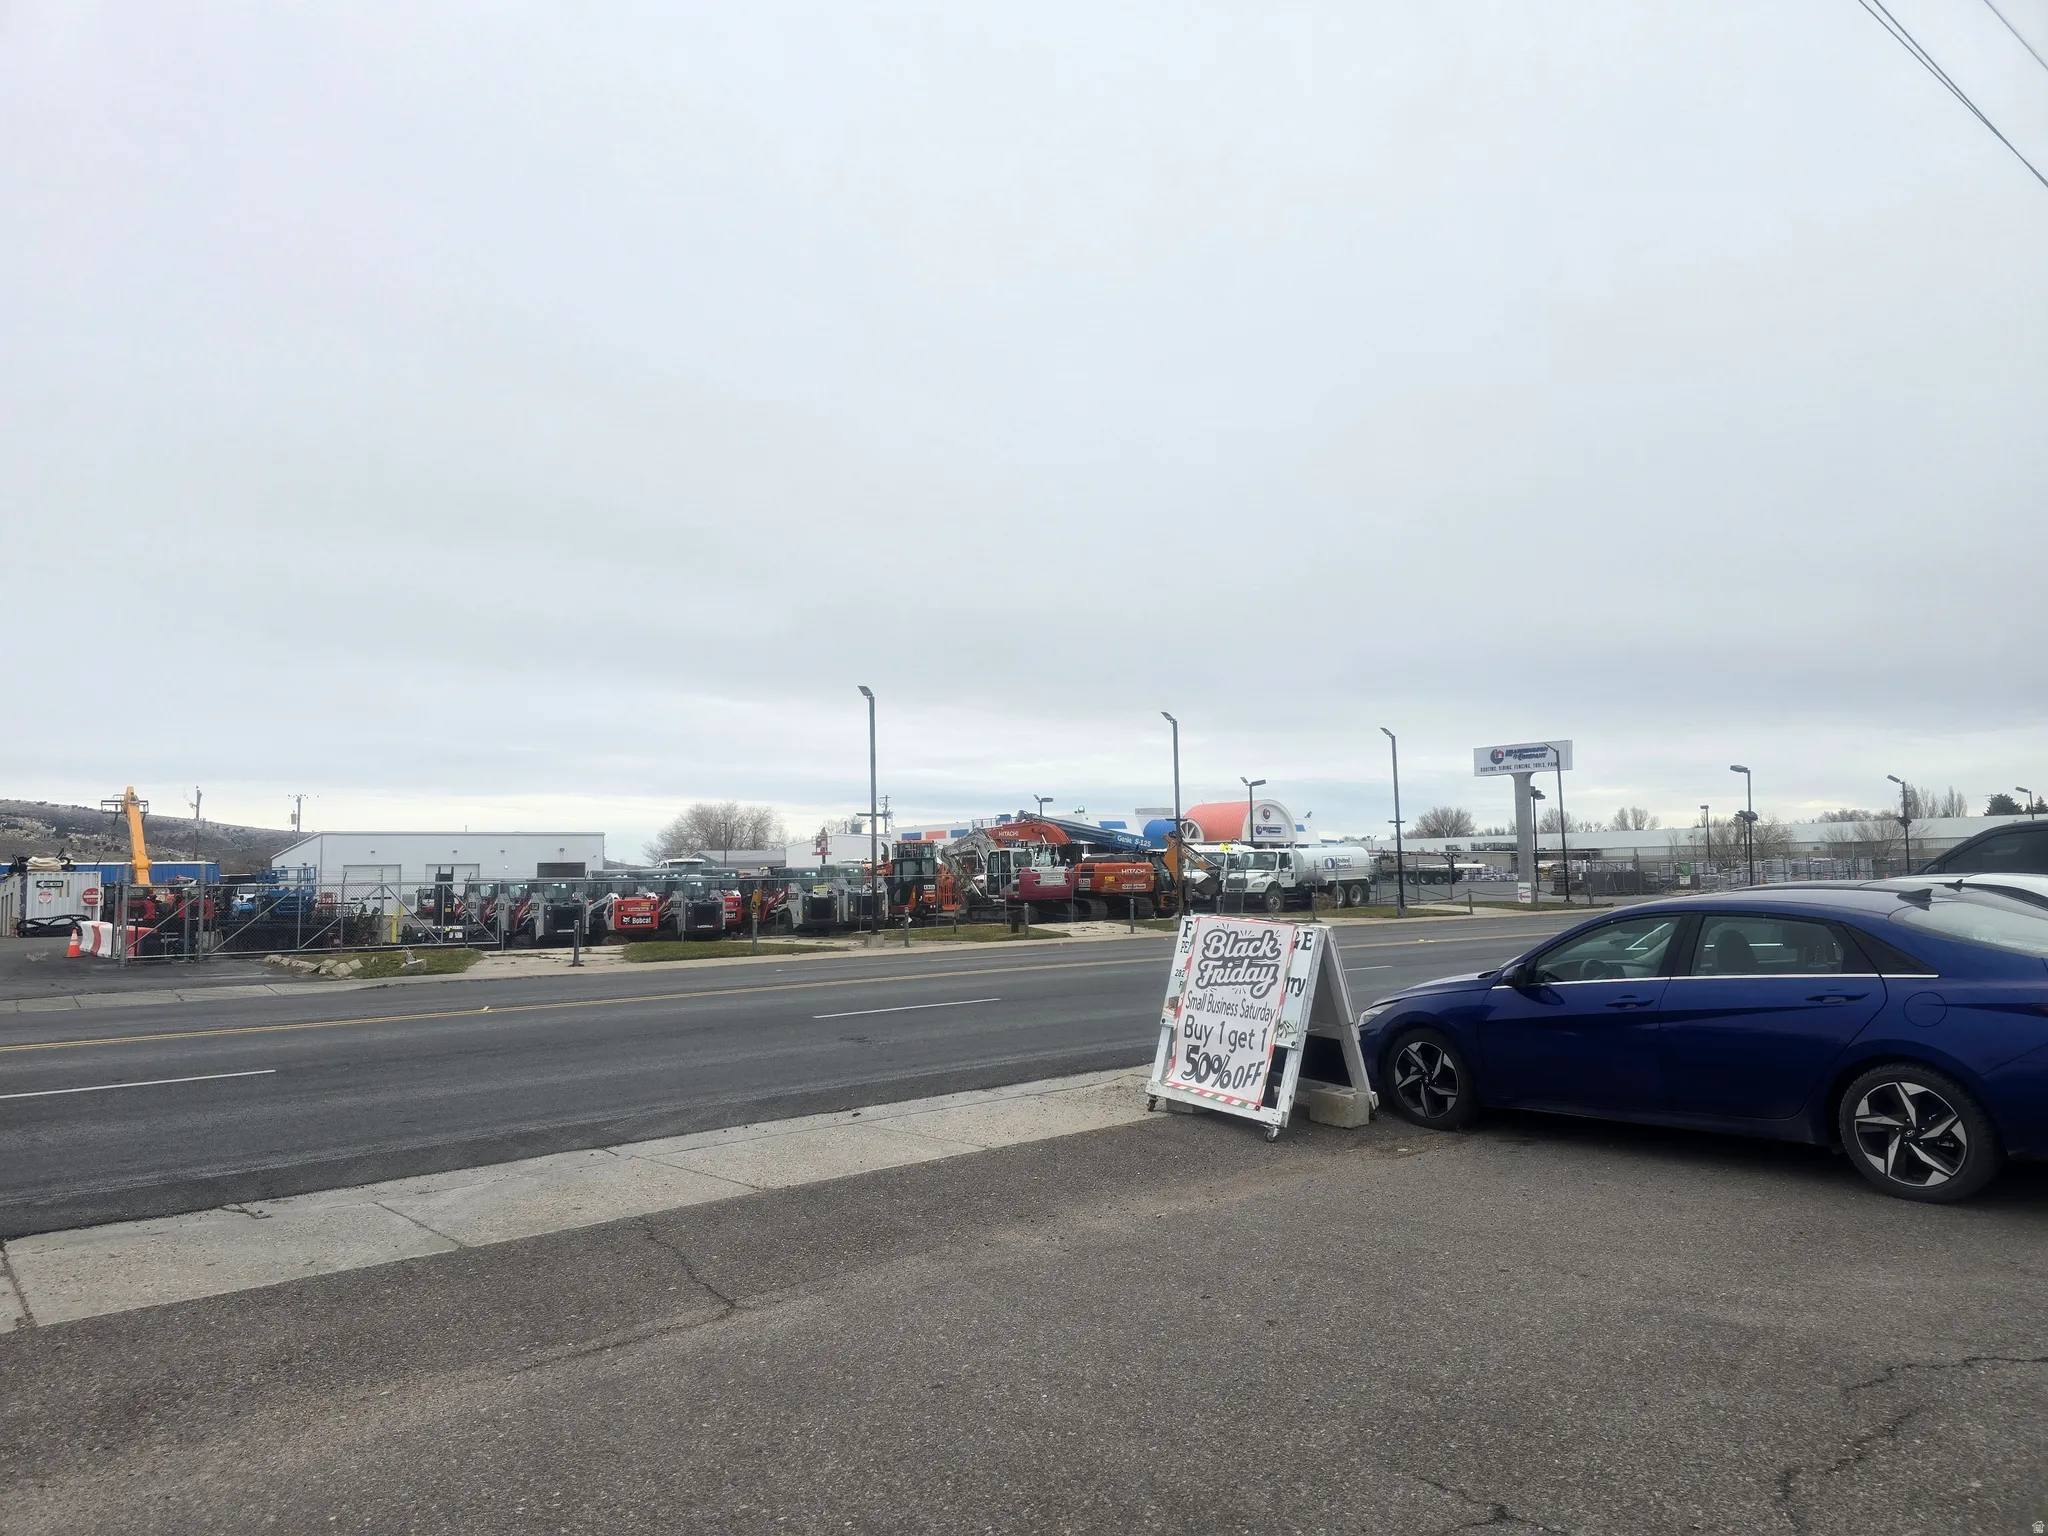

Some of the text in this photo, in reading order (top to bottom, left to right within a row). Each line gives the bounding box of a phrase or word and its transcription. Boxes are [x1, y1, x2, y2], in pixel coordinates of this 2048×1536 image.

[1117, 835, 1152, 848] Genie S-125
[1121, 868, 1146, 876] HITACHI
[1202, 929, 1282, 960] Black
[1196, 959, 1280, 998] Friday
[1185, 990, 1276, 1027] Small Business Saturday
[1183, 1014, 1268, 1053] Buy 1 get 1
[1180, 1044, 1266, 1090] 50% OFF
